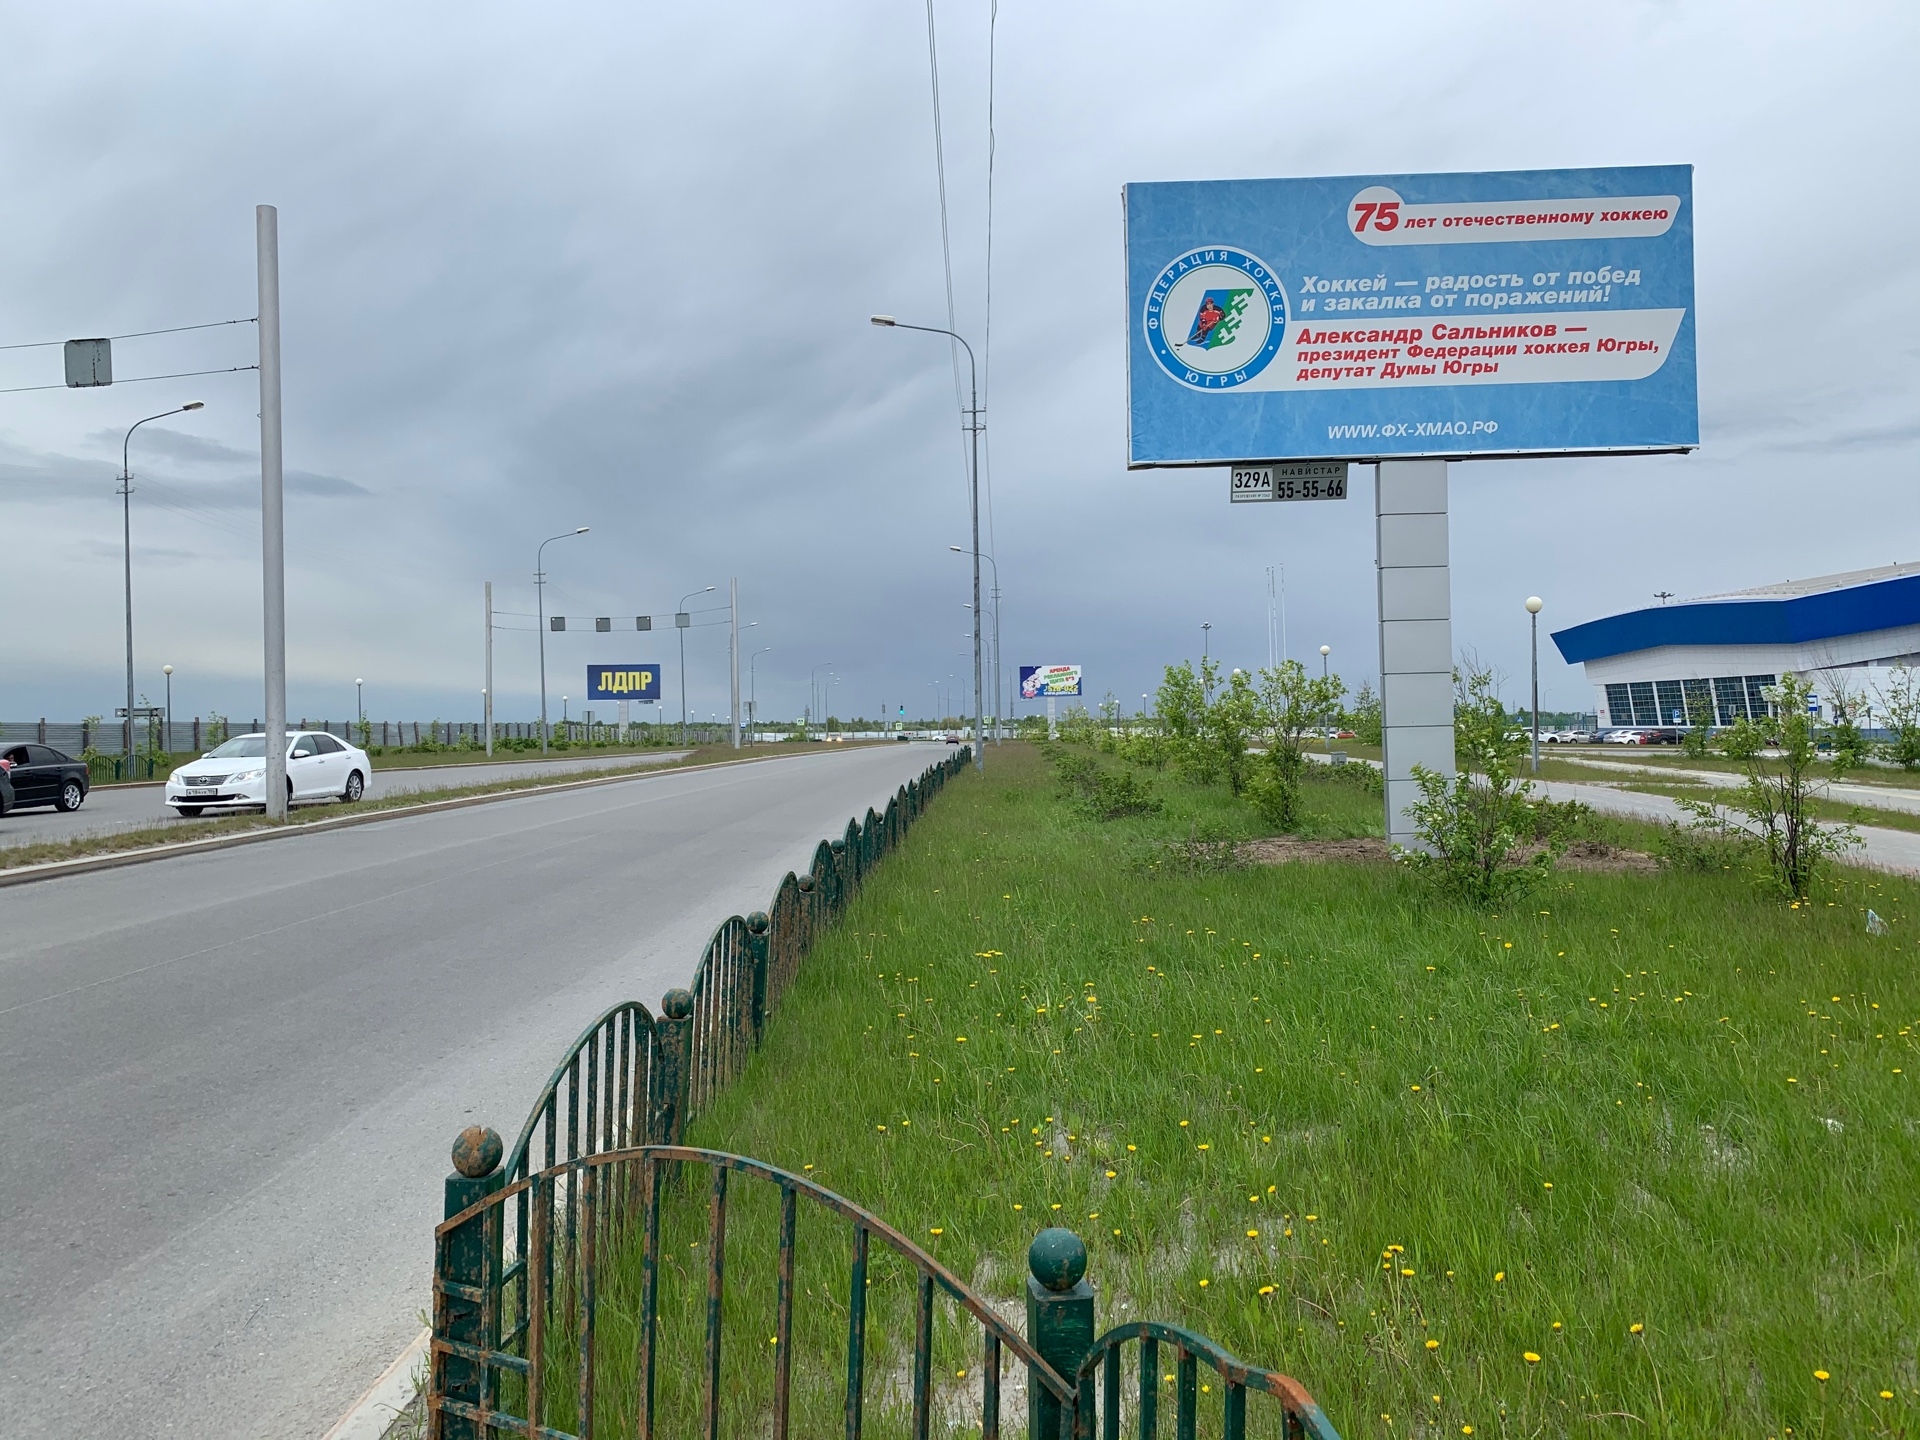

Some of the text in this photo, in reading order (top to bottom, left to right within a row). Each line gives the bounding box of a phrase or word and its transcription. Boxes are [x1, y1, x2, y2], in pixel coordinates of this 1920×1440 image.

[1354, 202, 1669, 233] 75 лет отечественному хоккею
[1148, 251, 1284, 330] ФЕДЕРАЦИЯ ХОККЕЯ
[1299, 273, 1388, 294] Хоккей
[1425, 273, 1524, 293] радость
[1532, 271, 1561, 286] от
[1567, 265, 1641, 286] побед
[1301, 284, 1611, 312] и закалка от поражений!
[1296, 328, 1423, 345] Александр
[1431, 323, 1557, 341] Сальников
[1297, 337, 1659, 364] президент Федерации хоккея Югры,
[1184, 370, 1248, 387] ЮГРЫ
[1296, 360, 1499, 381] депутат Думы Югры
[1327, 420, 1499, 440] WWW.ФХ-ХМАО.РФ
[1234, 471, 1271, 489] 329А
[1281, 466, 1341, 476] НАВИСТАР
[1277, 479, 1343, 499] 55-55-66
[597, 671, 653, 694] ЛДПР
